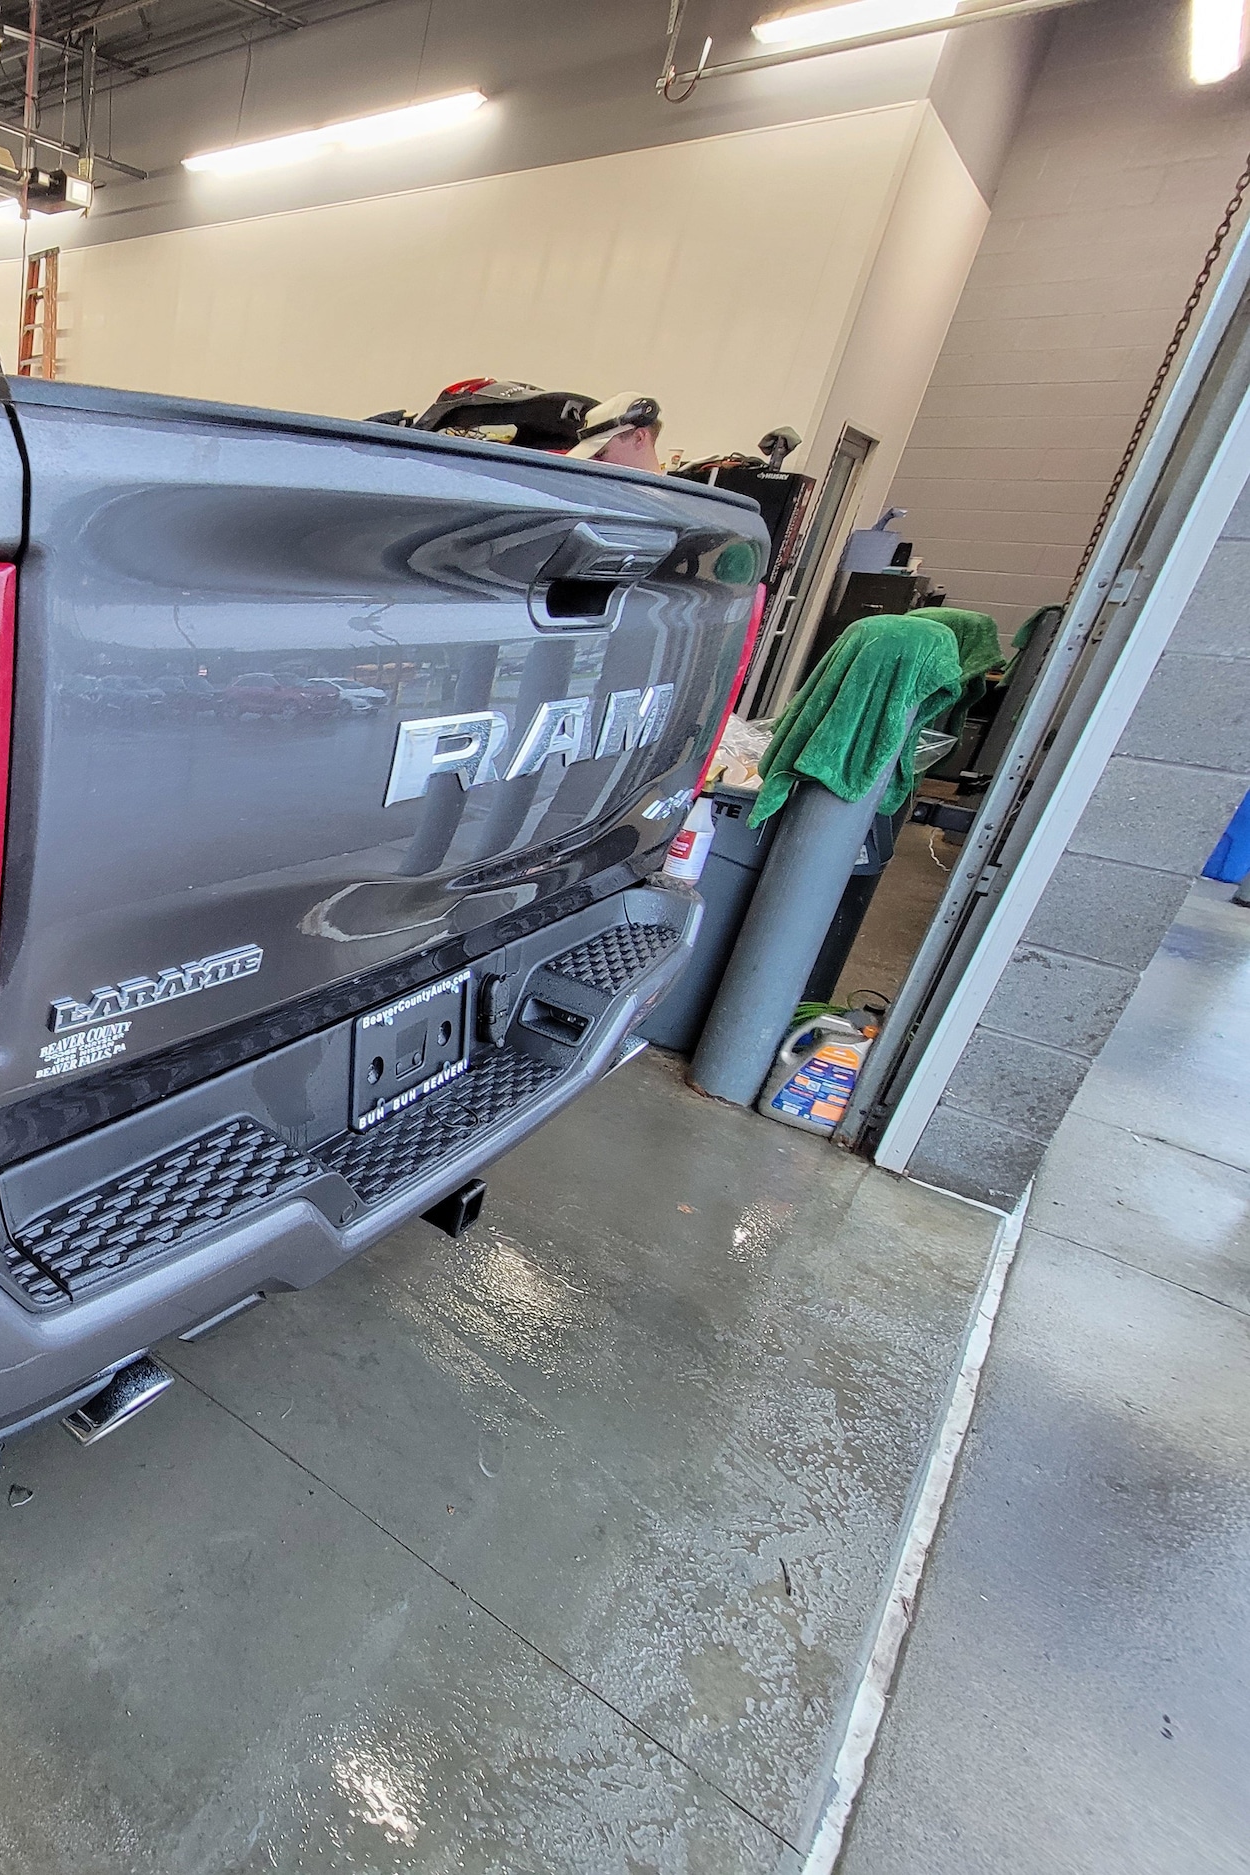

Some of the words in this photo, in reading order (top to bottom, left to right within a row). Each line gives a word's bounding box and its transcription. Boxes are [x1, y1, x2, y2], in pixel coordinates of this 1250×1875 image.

[765, 472, 790, 481] HUSKY
[383, 683, 675, 808] RAM
[48, 944, 264, 1034] LARAMIE
[362, 970, 471, 1029] BeaverCountyAuto.com
[35, 1059, 78, 1079] BEAVER
[39, 1032, 86, 1058] BEAVER
[87, 1021, 132, 1043] COUNTY
[358, 1107, 385, 1130] BUH
[393, 1089, 417, 1111] BUH
[422, 1058, 469, 1093] BEAVER!
